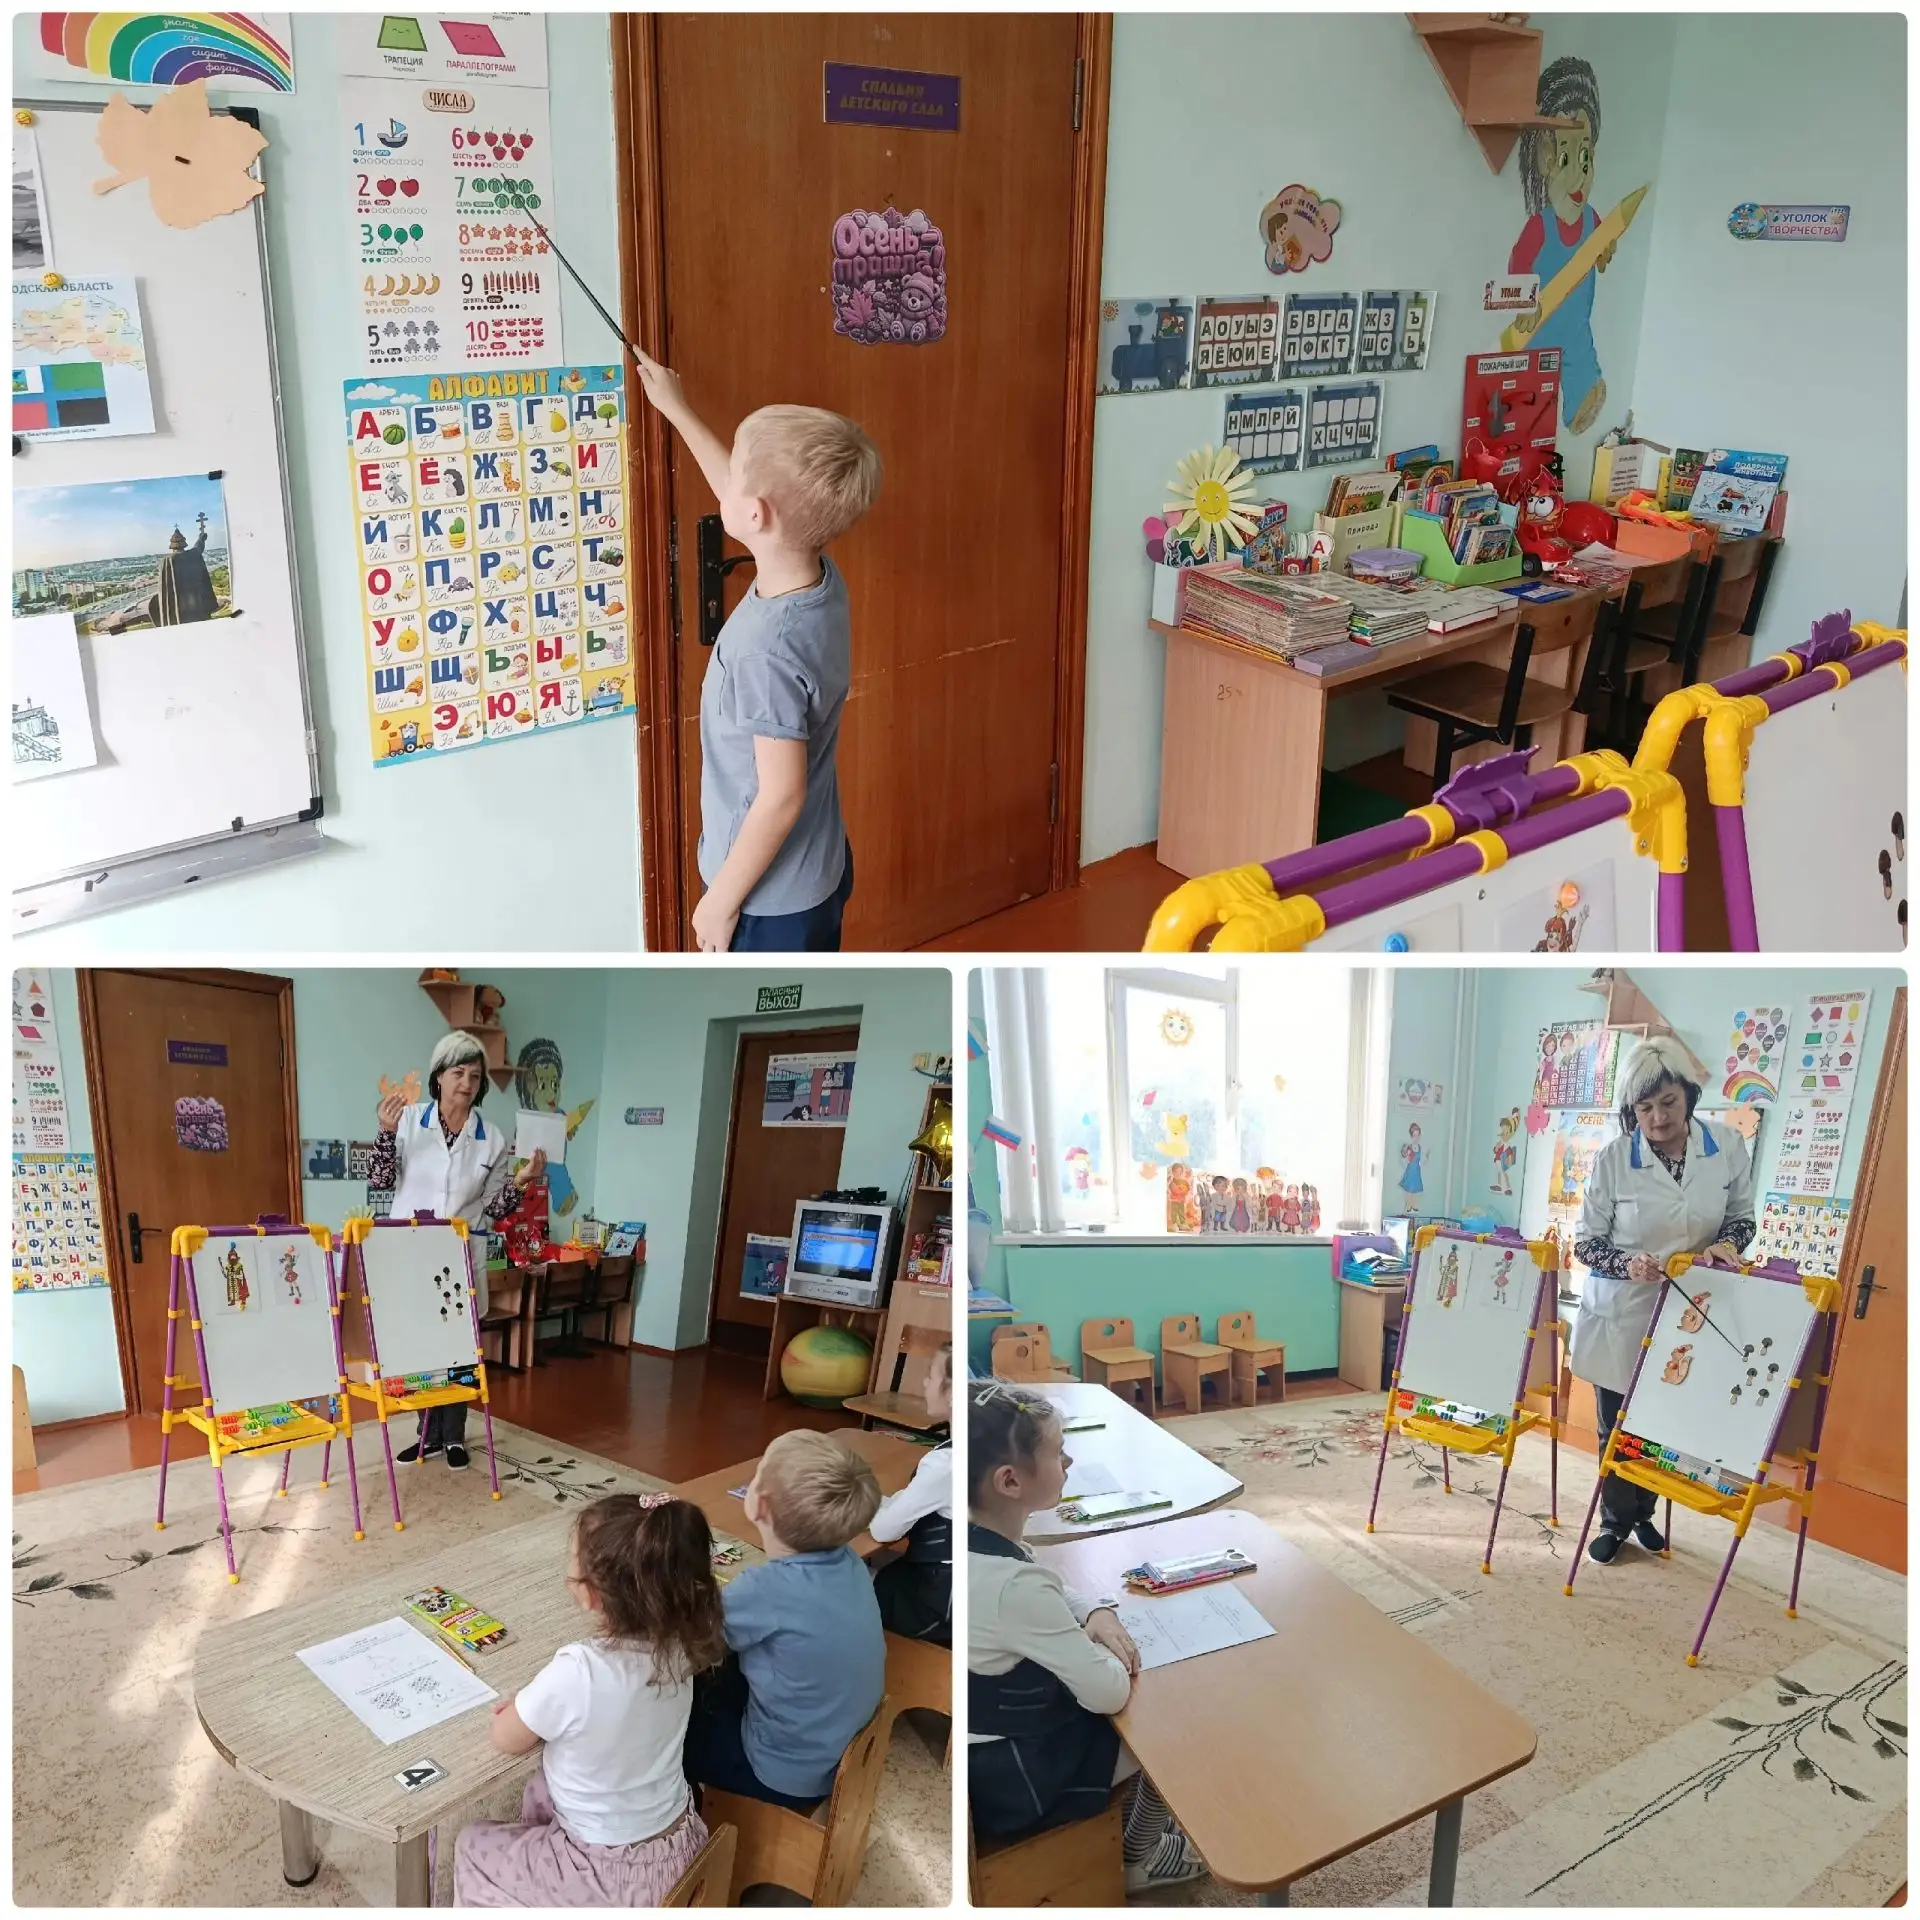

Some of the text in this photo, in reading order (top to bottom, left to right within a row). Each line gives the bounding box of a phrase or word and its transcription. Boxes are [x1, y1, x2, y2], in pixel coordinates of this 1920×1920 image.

[383, 55, 424, 67] ТРАПЕЦИЯ
[446, 60, 516, 73] ПАРАЛЛЕЛОГРАММ
[429, 91, 467, 108] ЧИСЛА
[354, 122, 365, 146] 1
[451, 127, 464, 149] 6
[352, 149, 373, 157] ОДИН
[356, 174, 371, 197] 2
[454, 176, 465, 198] 7
[1769, 225, 1839, 235] ТВОРЧЕСТВА
[1782, 213, 1828, 223] УГОЛОК
[360, 223, 374, 246] 3
[458, 223, 470, 245] 8
[61, 282, 114, 292] ОБЛАСТЬ
[363, 274, 376, 297] 4
[461, 272, 473, 294] 9
[367, 325, 380, 347] 5
[465, 321, 490, 342] 10
[1480, 359, 1514, 372] ПОЖАРНЫЙ
[428, 370, 549, 400] АЛФАВИТ
[471, 402, 493, 430] В
[526, 399, 543, 425] Г
[575, 395, 597, 421] Д
[356, 411, 381, 440] А
[414, 407, 437, 435] Б
[473, 452, 499, 480] Ж
[530, 448, 548, 474] З
[578, 443, 598, 469] И
[360, 463, 382, 492] Е
[420, 457, 440, 486] Ё
[529, 496, 553, 523] М
[579, 490, 602, 516] Н
[421, 509, 444, 537] К
[478, 502, 500, 530] Л
[363, 514, 388, 545] Й
[532, 544, 555, 570] С
[582, 537, 604, 562] Т
[1312, 540, 1325, 554] А
[398, 565, 410, 573] ОСА
[424, 558, 451, 587] П
[480, 551, 501, 579] Р
[367, 568, 392, 595] О
[534, 591, 559, 618] Ц
[584, 583, 606, 607] Ч
[427, 609, 458, 634] Ф
[483, 599, 508, 627] Х
[372, 617, 395, 647] У
[586, 630, 607, 653] Ь
[484, 648, 511, 673] Ъ
[536, 636, 563, 663] Ы
[374, 665, 405, 695] Ш
[431, 655, 463, 684] Щ
[486, 692, 516, 721] Ю
[539, 681, 562, 710] Я
[434, 704, 459, 730] Э
[758, 994, 799, 1010] ВЫХОД
[760, 986, 800, 997] ЗАПАСНЫЙ
[1576, 1115, 1605, 1126] ОСЕНЬ
[402, 1767, 437, 1787] 4
